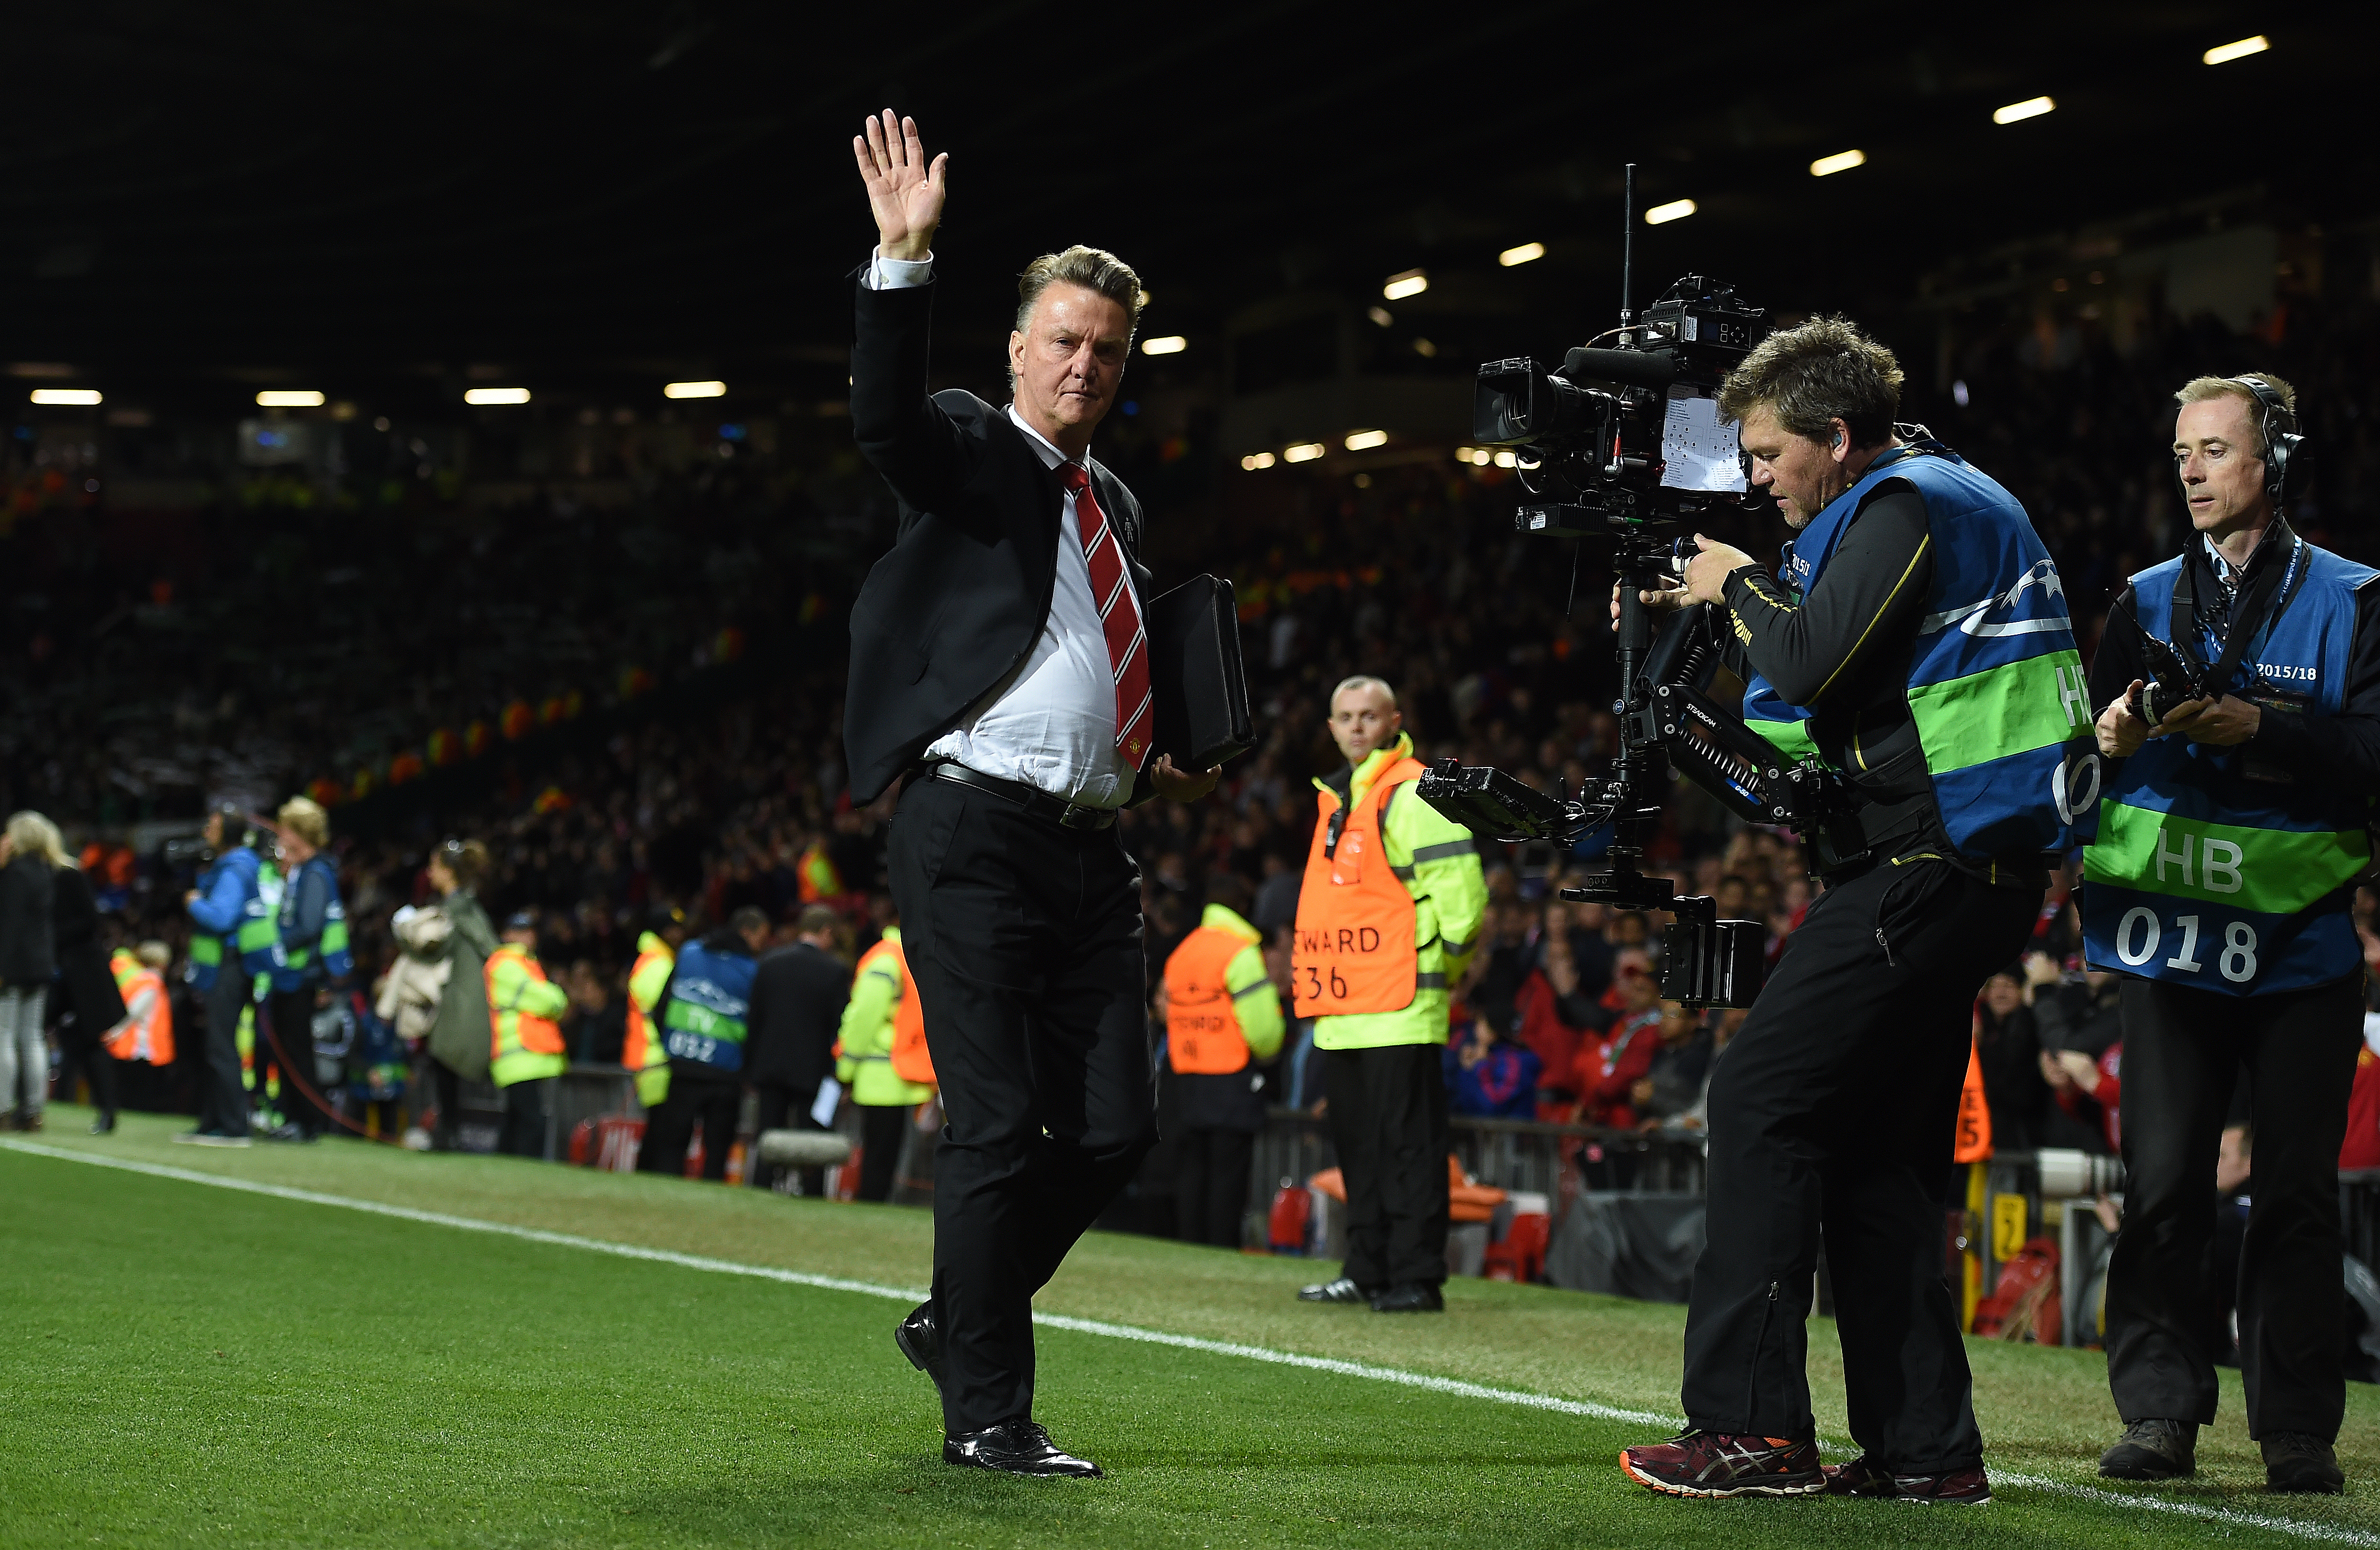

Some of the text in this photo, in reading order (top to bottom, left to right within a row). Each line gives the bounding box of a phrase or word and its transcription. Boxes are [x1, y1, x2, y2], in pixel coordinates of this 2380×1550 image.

[2256, 663, 2316, 680] 2015/18
[1686, 703, 1717, 728] STEADICAM
[2156, 828, 2243, 893] HB
[1294, 927, 1380, 953] WARD
[2116, 906, 2257, 982] 018
[1293, 966, 1347, 999] 36
